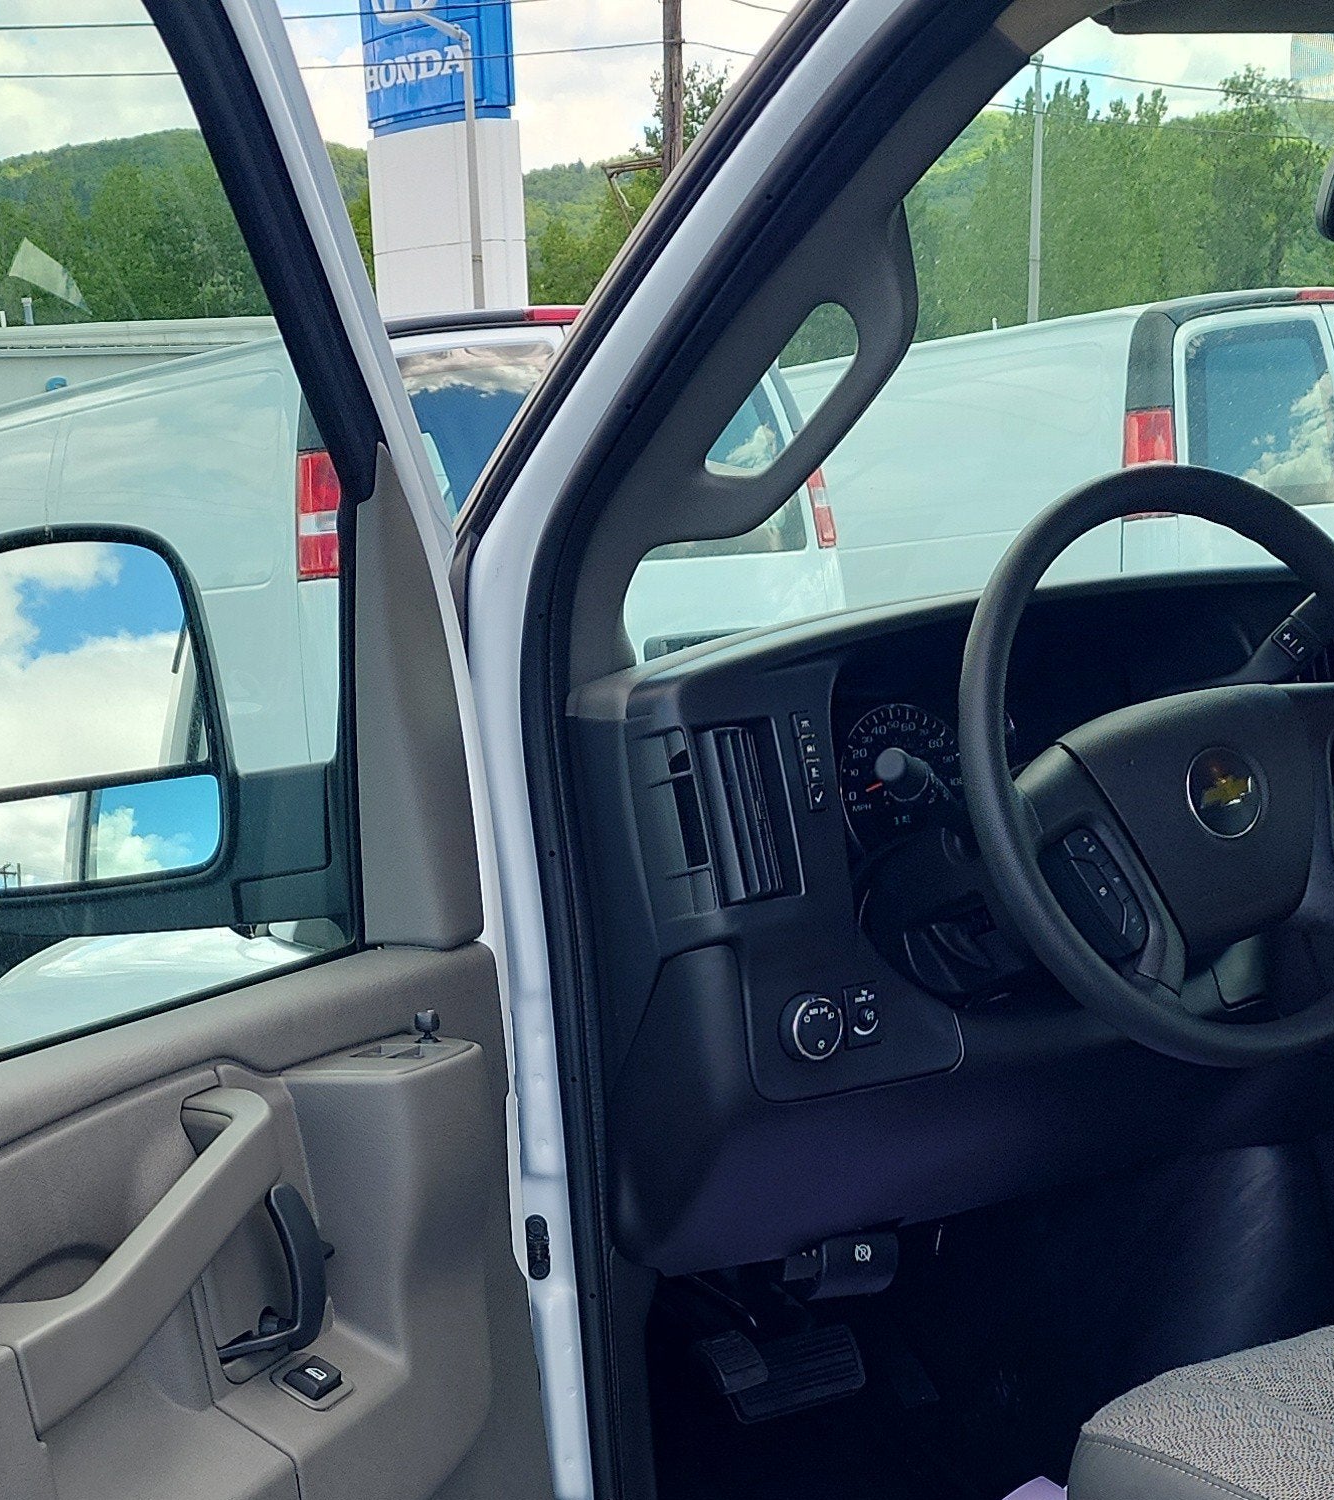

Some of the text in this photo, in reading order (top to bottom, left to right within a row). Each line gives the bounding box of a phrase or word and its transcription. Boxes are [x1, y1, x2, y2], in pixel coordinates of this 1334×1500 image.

[365, 45, 464, 93] HONDA
[871, 724, 887, 735] 40
[852, 748, 868, 760] 20
[848, 791, 857, 801] 0
[852, 803, 872, 812] MPH
